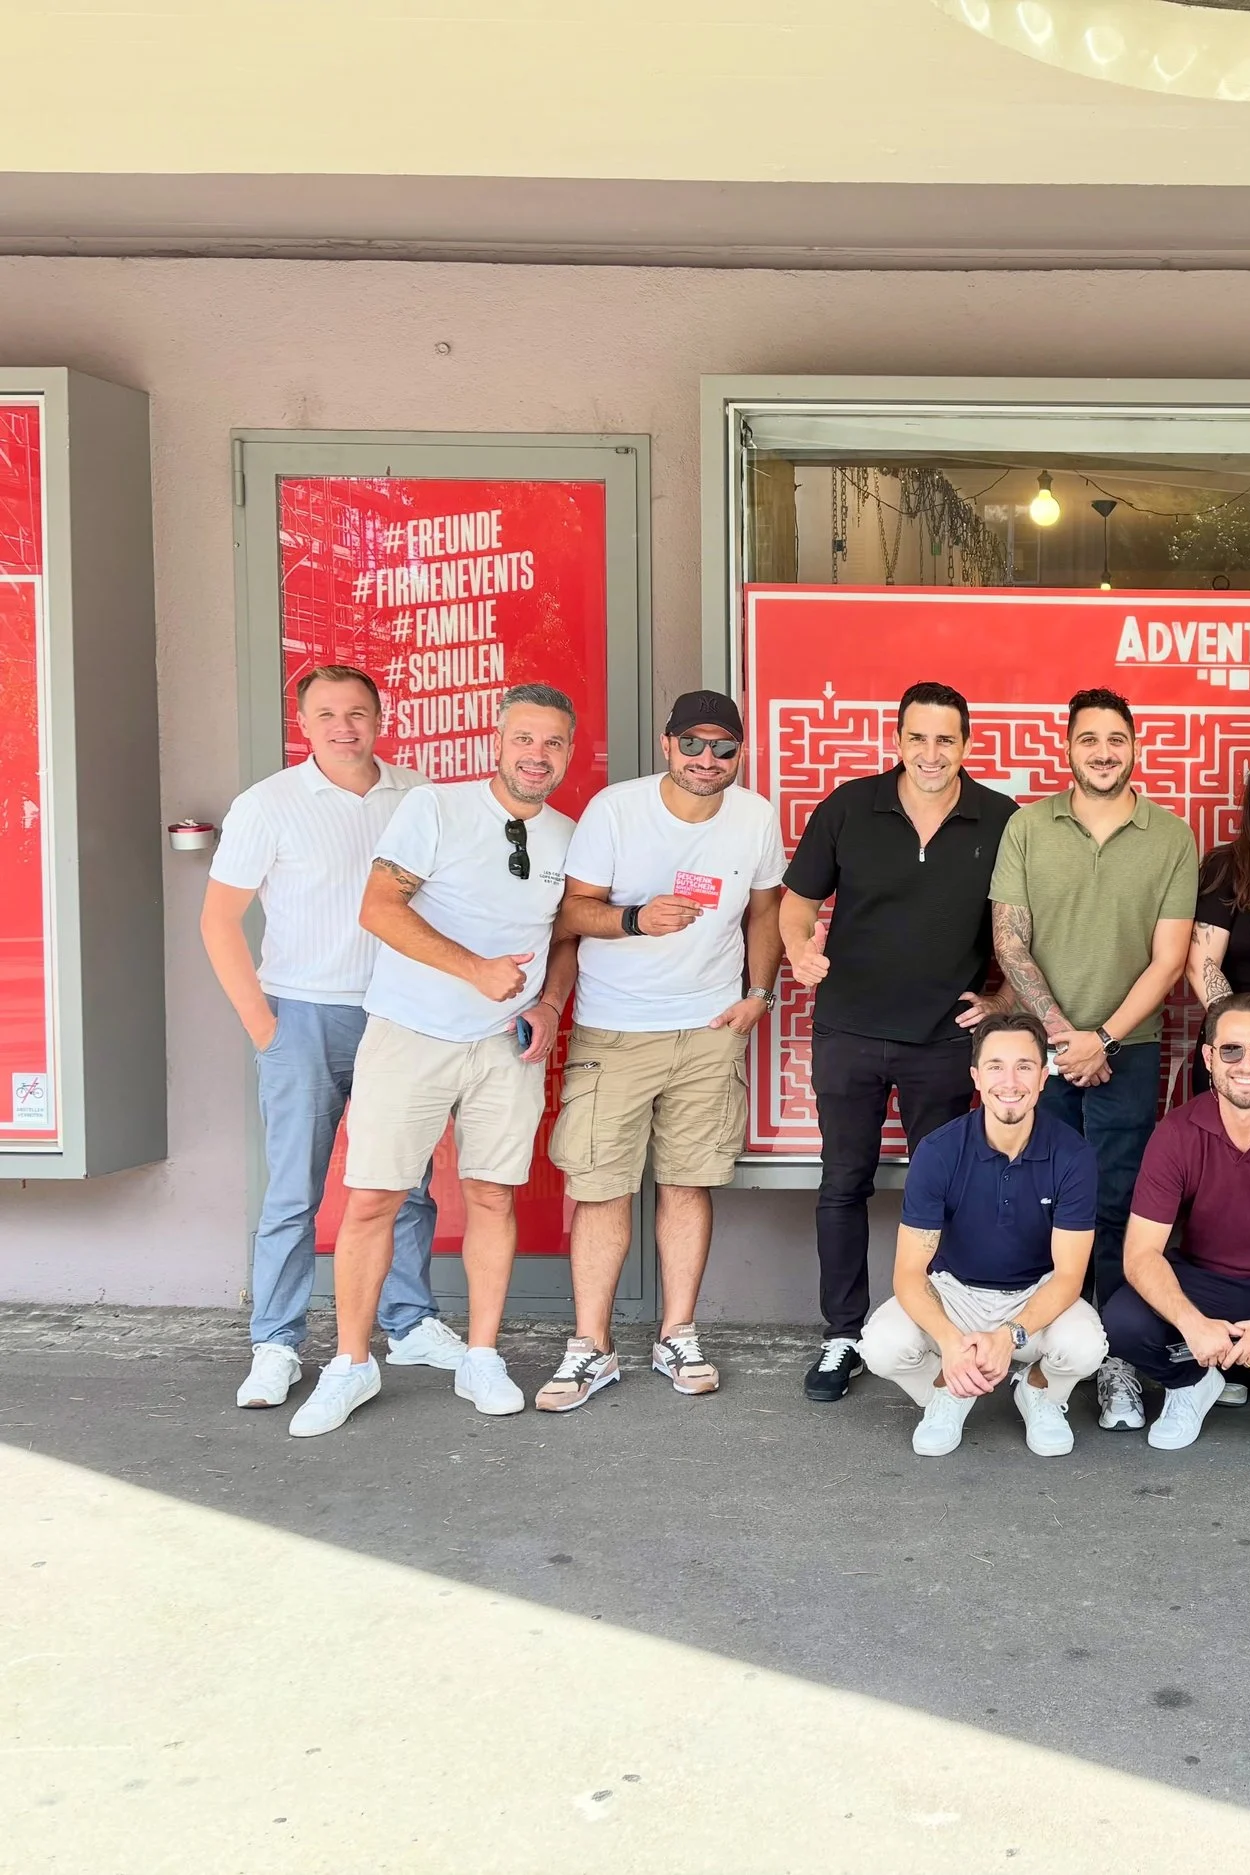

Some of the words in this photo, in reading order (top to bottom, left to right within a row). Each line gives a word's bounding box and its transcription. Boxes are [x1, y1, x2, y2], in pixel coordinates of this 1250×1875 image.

[382, 509, 503, 558] #FREUNDE
[351, 550, 535, 609] #FIRMENEVENTS
[391, 599, 498, 648] #FAMILIE
[384, 642, 504, 693] #SCHULEN
